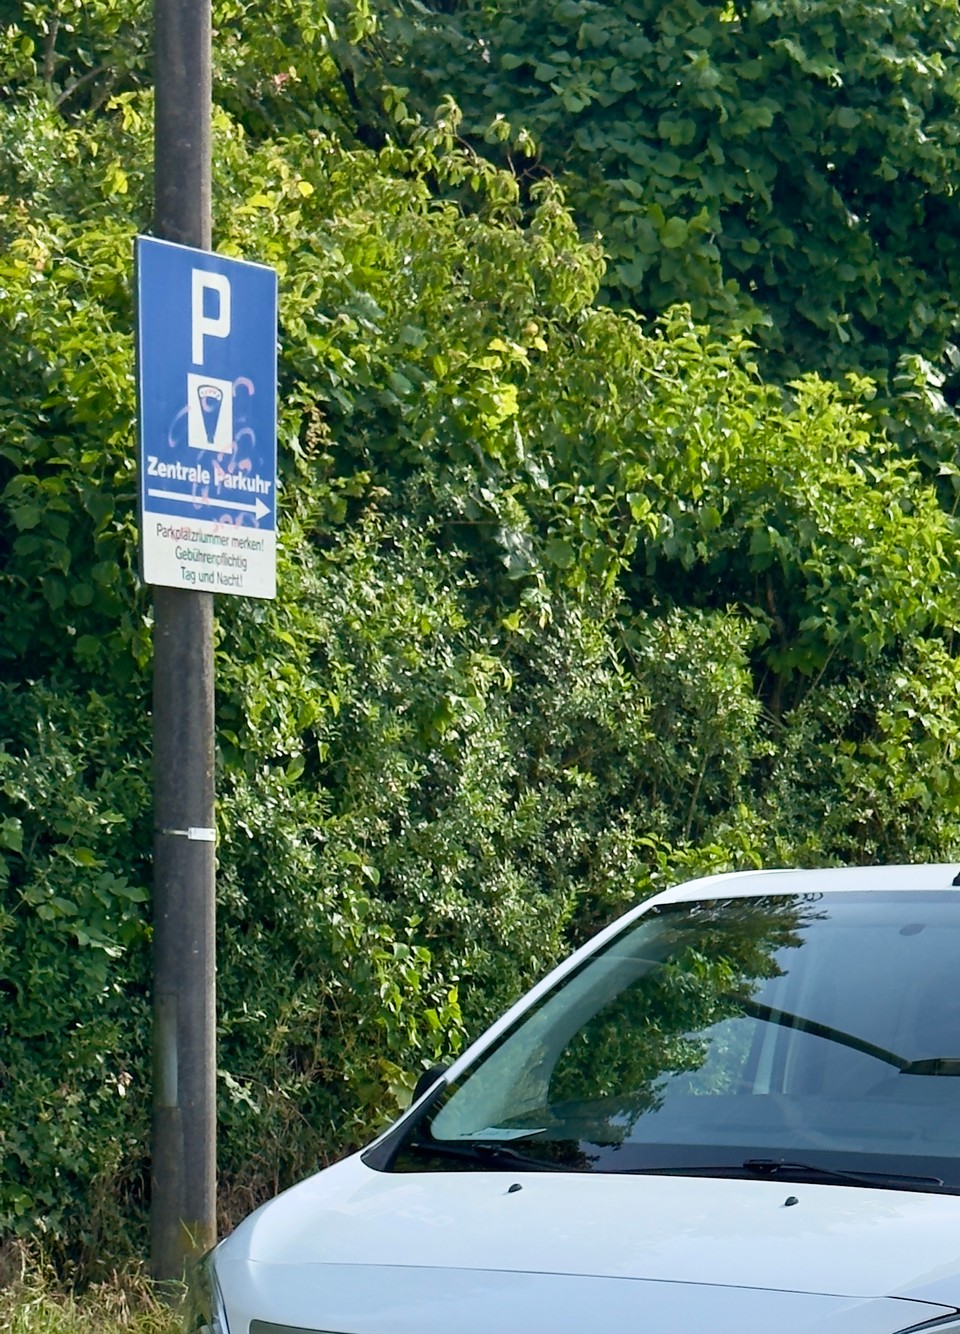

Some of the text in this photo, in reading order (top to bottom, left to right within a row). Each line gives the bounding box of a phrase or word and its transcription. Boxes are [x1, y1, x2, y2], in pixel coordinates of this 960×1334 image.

[191, 268, 231, 366] P
[147, 456, 272, 495] Zentrale Parkuhr
[156, 523, 264, 552] Parkplatznummer merken!
[175, 546, 247, 571] Gebührenpflichtig
[181, 566, 243, 588] Tag und Nacht!
